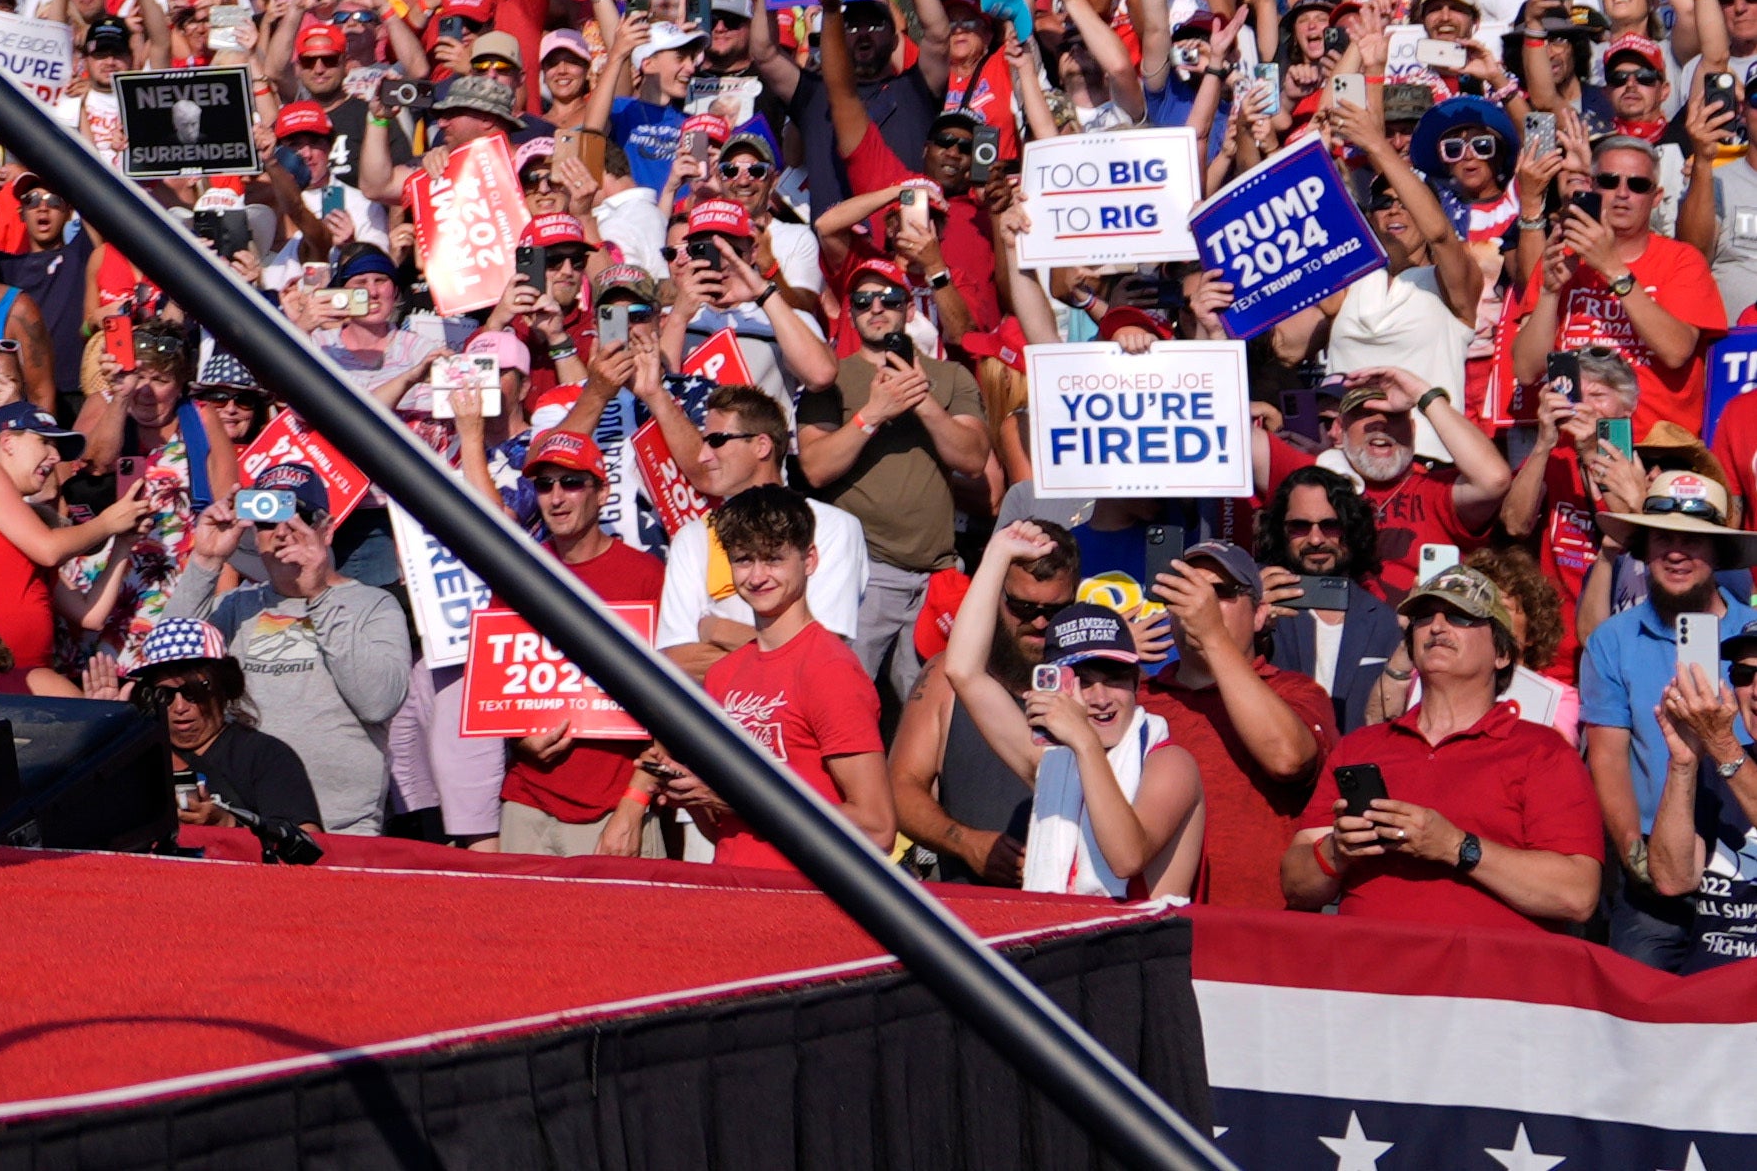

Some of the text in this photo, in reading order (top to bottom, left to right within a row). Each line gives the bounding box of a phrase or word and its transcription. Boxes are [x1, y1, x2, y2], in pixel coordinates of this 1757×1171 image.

[135, 82, 231, 110] NEVER
[132, 141, 250, 165] SURRENDER
[1037, 159, 1169, 190] TOO BIG
[454, 176, 506, 270] 2024
[1048, 203, 1159, 233] TO RIG
[1206, 175, 1326, 265] TRUMP
[1231, 214, 1330, 289] 2024
[1230, 236, 1363, 314] TEXT TRUMP TO 88022
[1058, 372, 1215, 392] CROOKED JOE
[1060, 391, 1215, 422] YOU'RE
[1050, 425, 1229, 466] FIRED!
[1059, 629, 1088, 648] GREAT
[241, 659, 315, 677] patagonia
[478, 700, 512, 712] TEXT
[515, 698, 565, 711] TRUMP
[568, 698, 588, 711] TO
